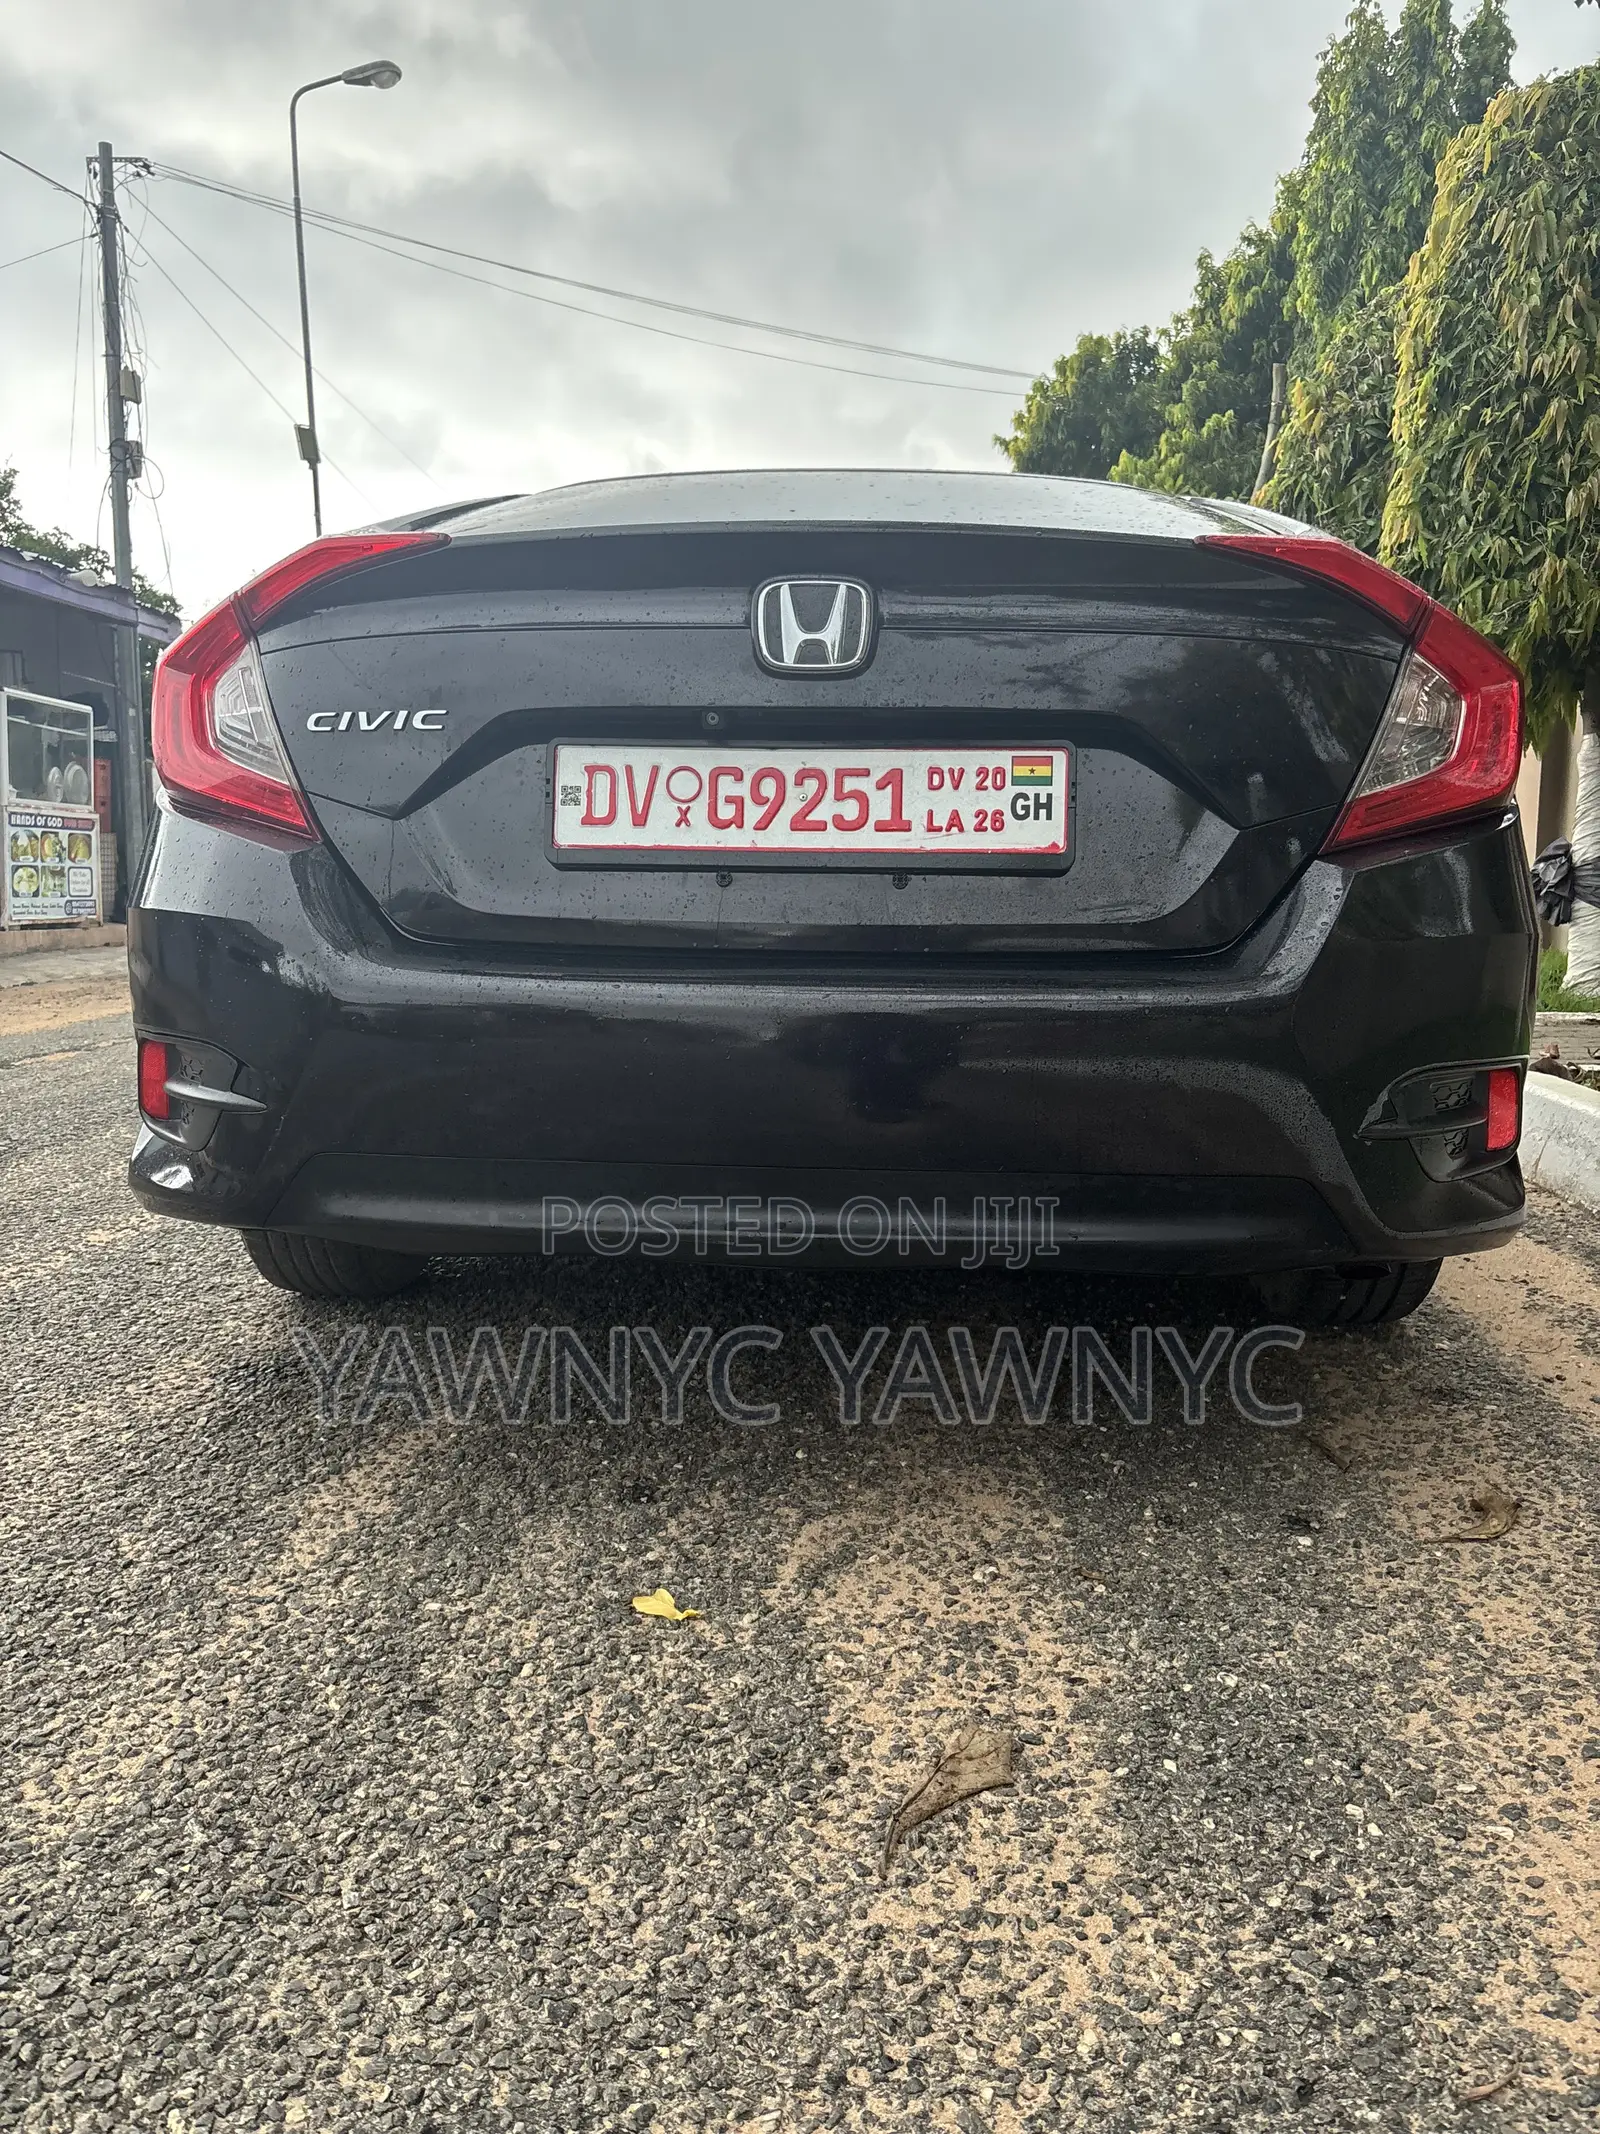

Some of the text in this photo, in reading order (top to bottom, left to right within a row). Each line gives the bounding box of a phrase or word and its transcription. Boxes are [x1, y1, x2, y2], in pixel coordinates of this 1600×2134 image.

[306, 709, 449, 732] CIVIC
[927, 766, 1006, 791] DV 20
[581, 764, 660, 827] DV
[707, 766, 912, 832] G9251
[1010, 792, 1053, 821] GH
[47, 816, 63, 828] GOD
[926, 809, 1005, 833] LA 26
